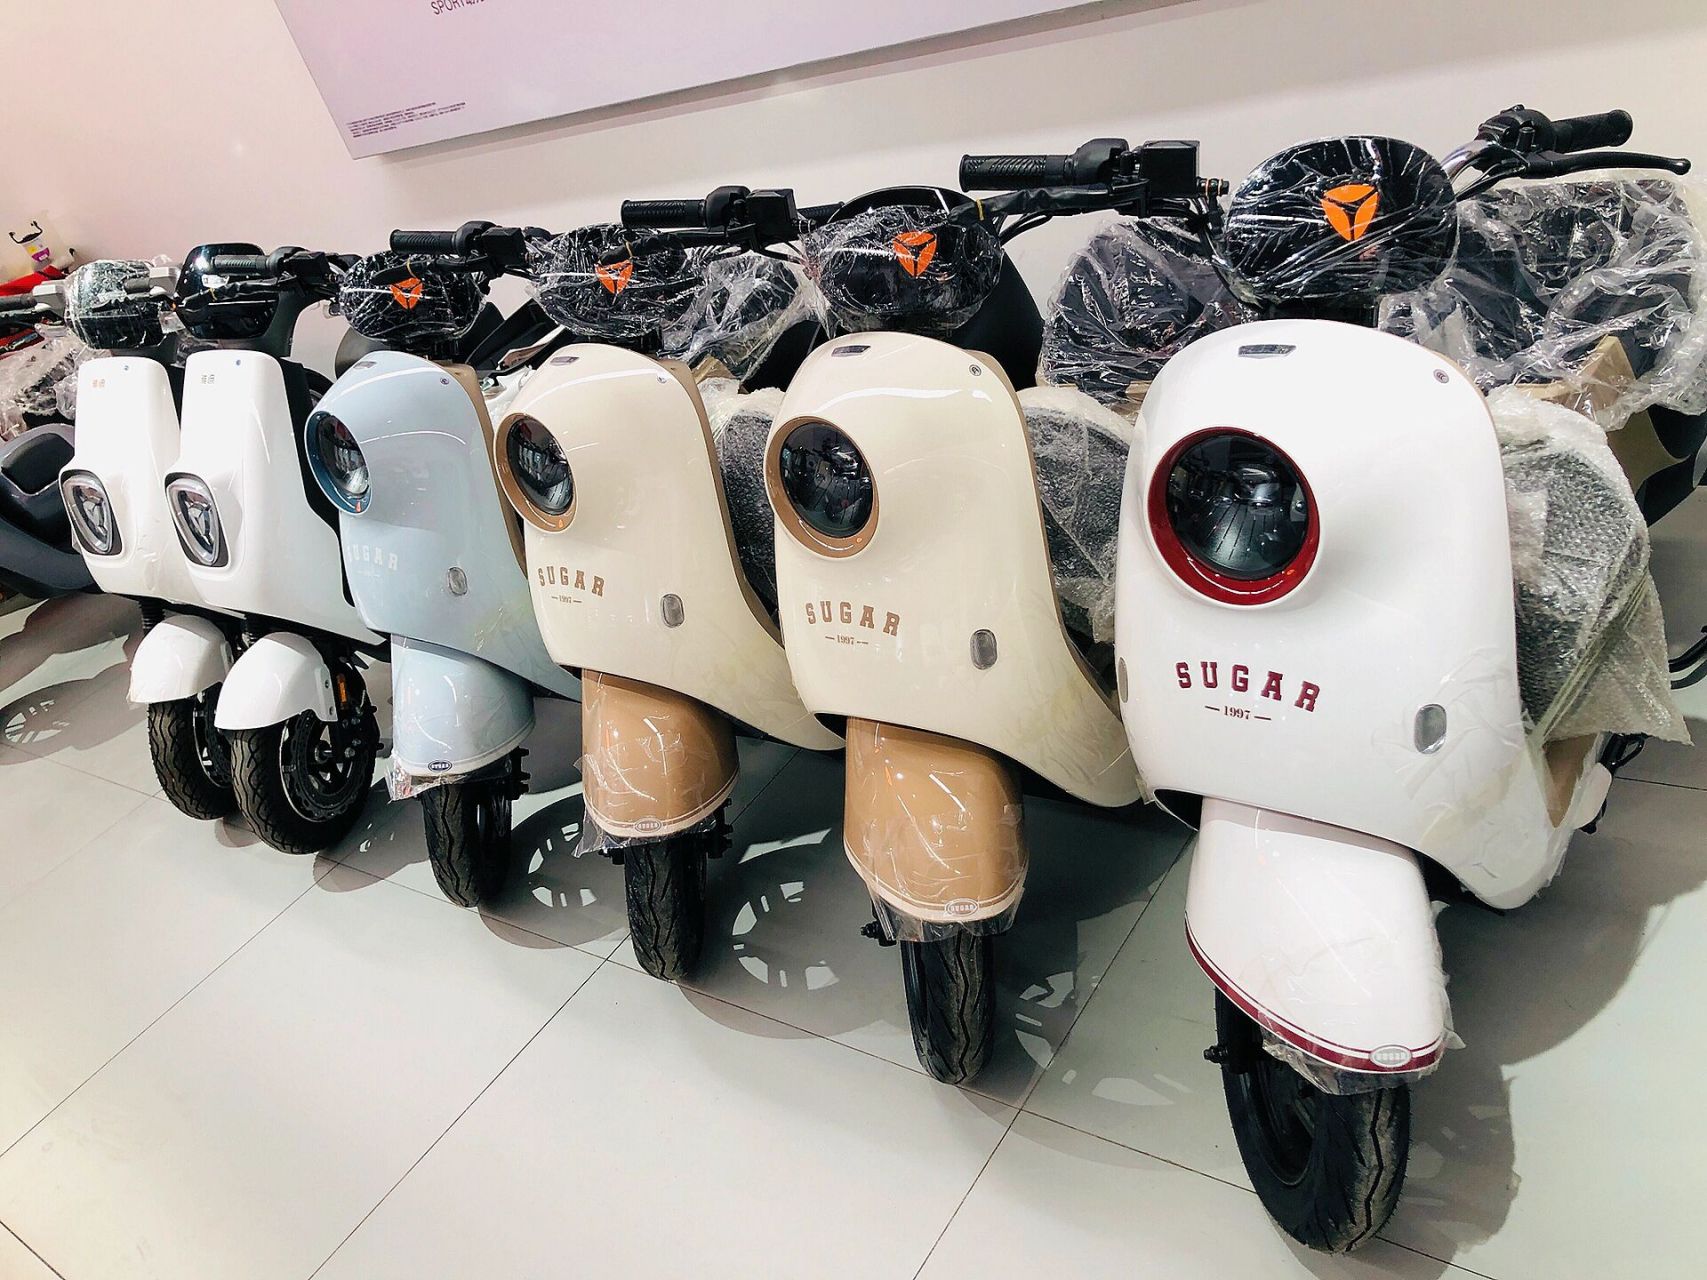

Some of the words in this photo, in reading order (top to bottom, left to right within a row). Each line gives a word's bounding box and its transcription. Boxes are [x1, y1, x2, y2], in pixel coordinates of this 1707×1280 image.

[537, 566, 605, 597] SUGAR
[805, 600, 901, 637] SUGAR
[836, 634, 855, 645] 1997
[1175, 661, 1321, 713] SUGAR
[1223, 705, 1251, 720] 1997
